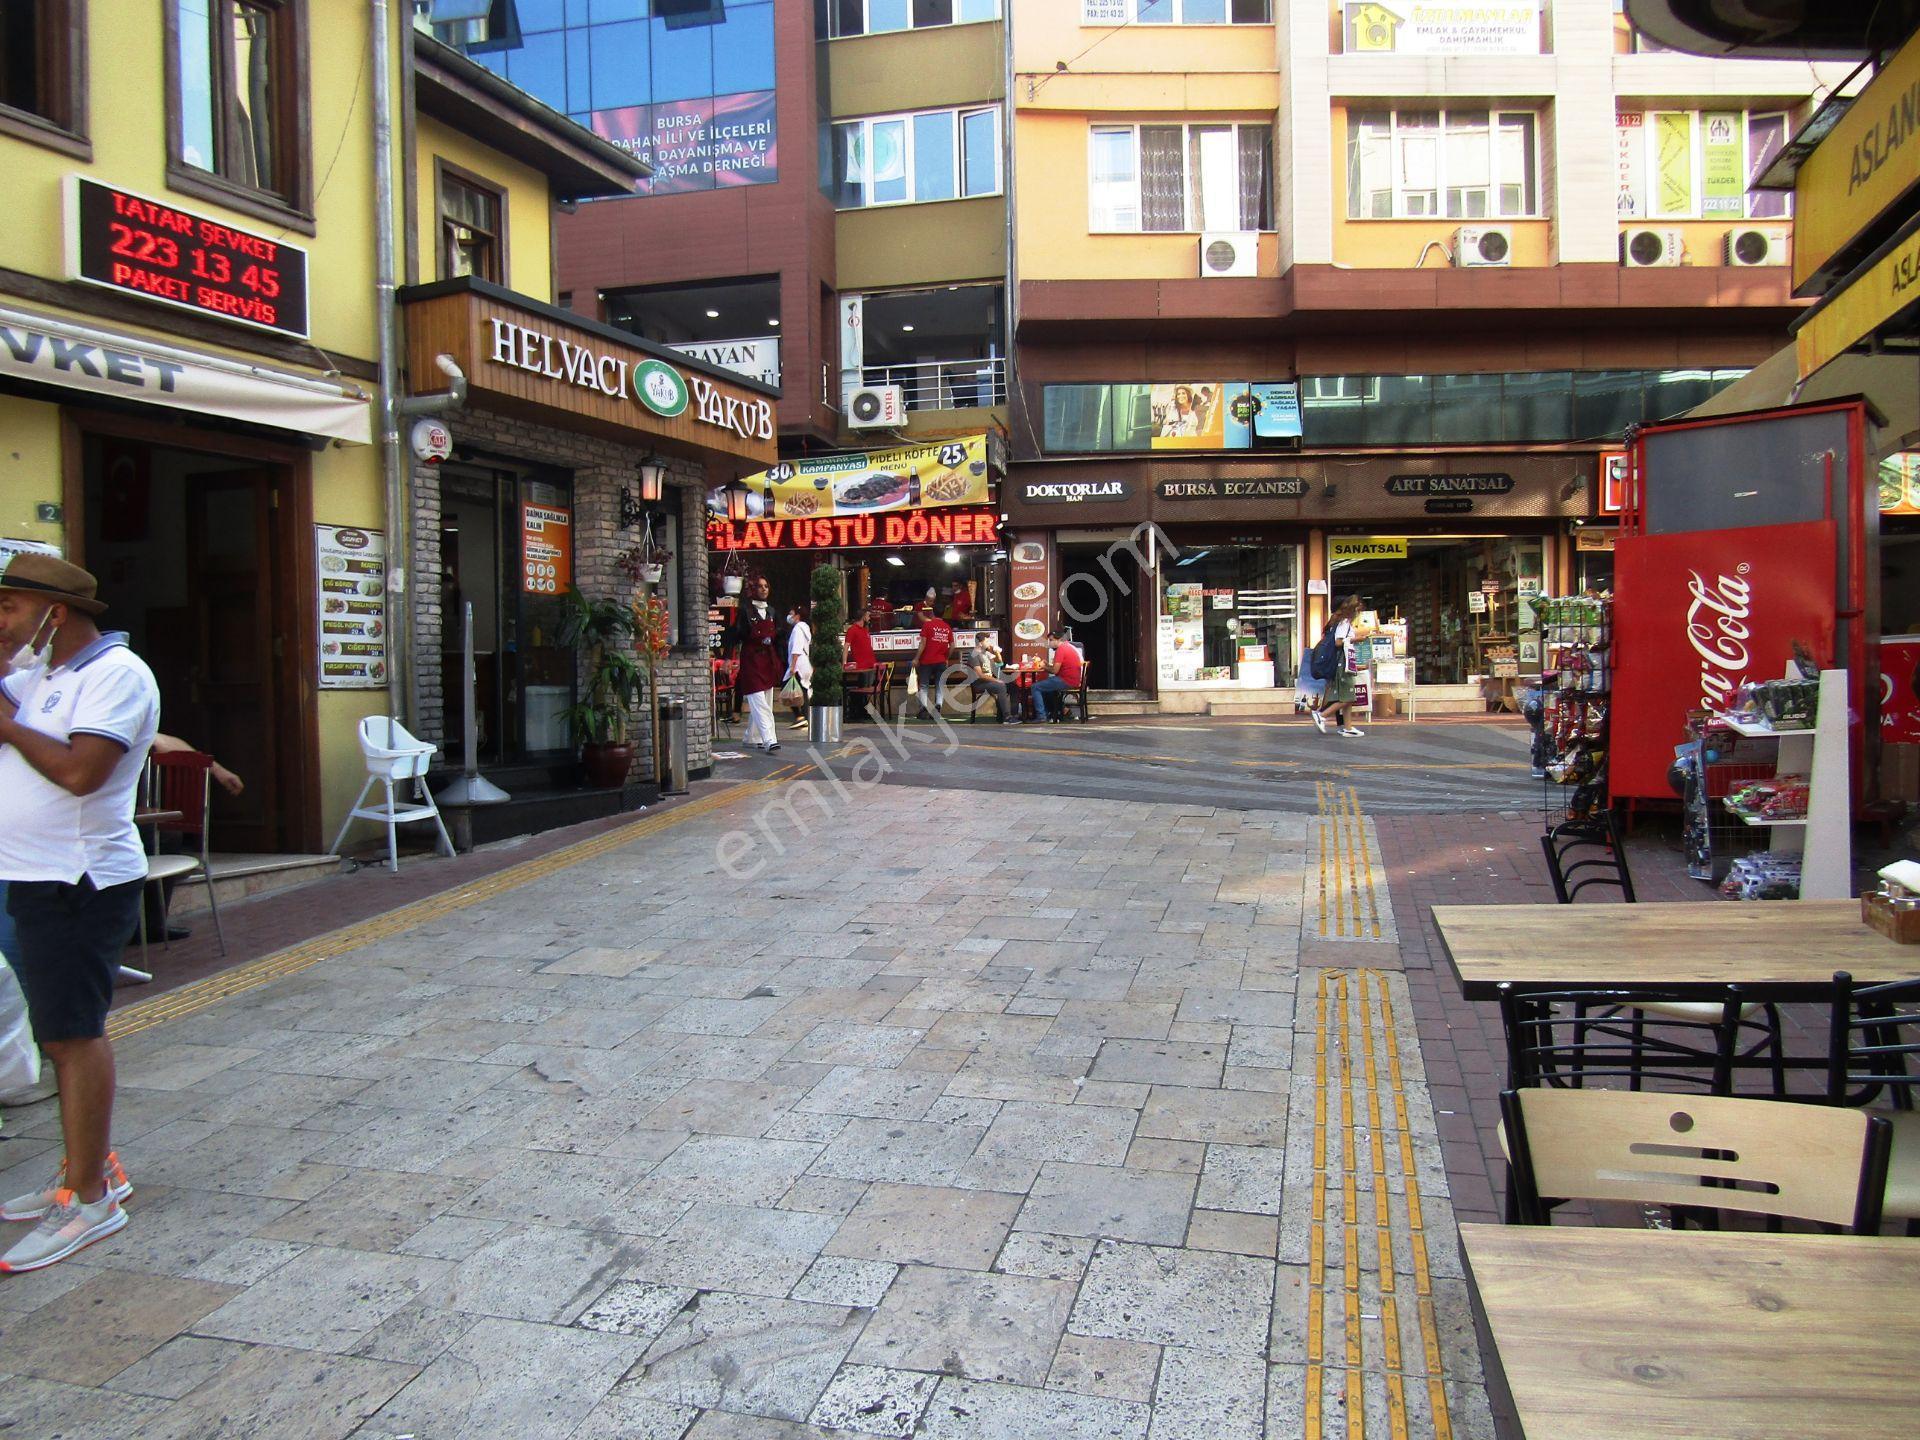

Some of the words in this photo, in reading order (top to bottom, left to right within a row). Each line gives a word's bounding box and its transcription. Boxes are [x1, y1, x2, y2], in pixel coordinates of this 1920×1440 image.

[657, 114, 702, 130] BURSA
[688, 129, 706, 143] VE
[710, 119, 772, 141] İLÇELERİ
[1848, 80, 1920, 197] ASLAN
[659, 141, 743, 162] DAYANIŞMA
[748, 139, 767, 152] VE
[703, 152, 767, 174] DERNEĞİ
[111, 192, 193, 233] TATAR
[200, 222, 279, 263] ŞEVKET
[110, 222, 179, 268] 223
[190, 248, 232, 285] 13
[241, 265, 281, 299] 45
[112, 262, 191, 302] PAKET
[198, 286, 278, 326] SERVİS
[491, 317, 629, 400] HELVACI
[690, 376, 775, 441] YAKUB
[885, 390, 893, 422] VESTEL
[905, 446, 939, 461] KÖFTE
[802, 461, 866, 473] KAMPANYASI
[1026, 482, 1123, 498] DOKTORLAR
[1164, 483, 1218, 496] BURSA
[1224, 479, 1303, 495] ECZANESİ
[1392, 479, 1426, 492] ART
[1428, 476, 1509, 492] SANATSAL
[1066, 494, 1084, 502] HAN
[45, 506, 56, 520] 2
[884, 510, 998, 545] DÖNER
[1335, 543, 1403, 555] SANATSAL
